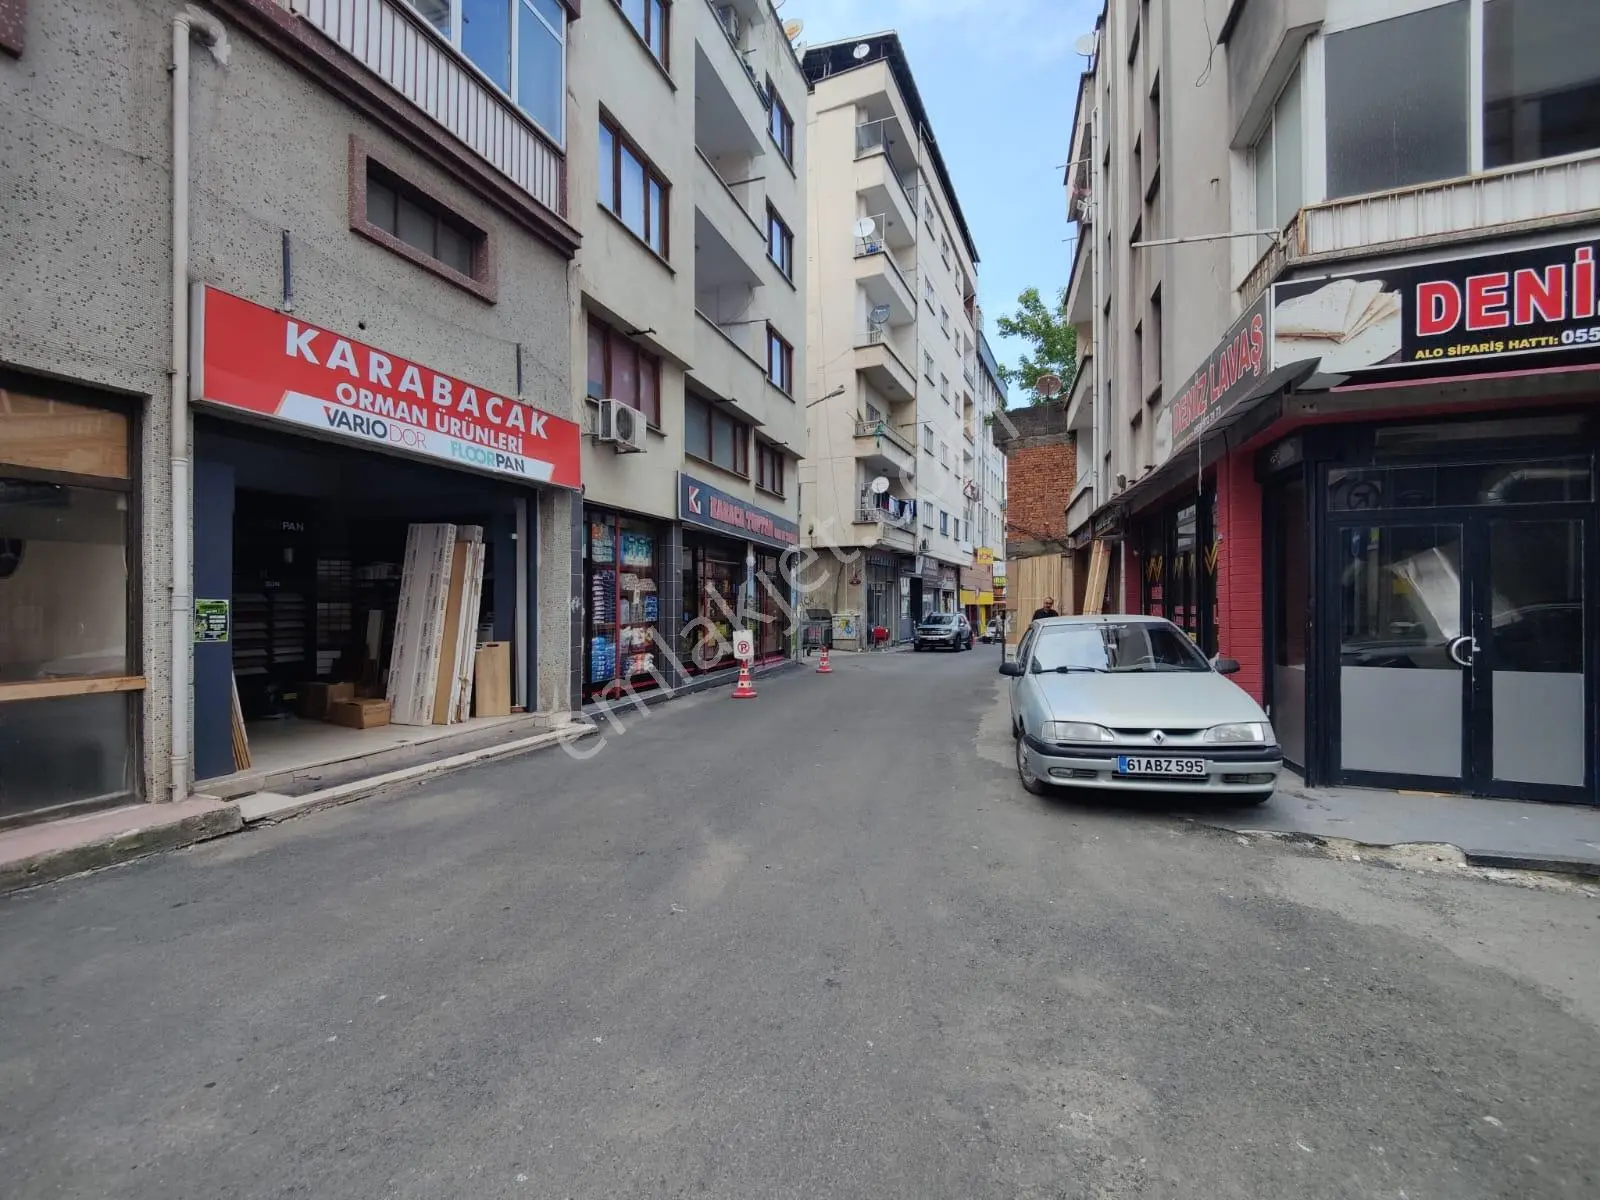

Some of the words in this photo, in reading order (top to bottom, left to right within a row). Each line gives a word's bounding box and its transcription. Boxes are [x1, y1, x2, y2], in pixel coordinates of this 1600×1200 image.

[1416, 246, 1600, 337] DENİ
[286, 321, 548, 439] KARABACAK
[1172, 372, 1207, 439] DENİZ
[1209, 313, 1263, 404] LAVAŞ
[1415, 348, 1443, 359] ALO
[1449, 340, 1504, 357] SİPARİŞ
[336, 383, 428, 427] ORMAN
[435, 407, 523, 454] ÜRÜNLERİ
